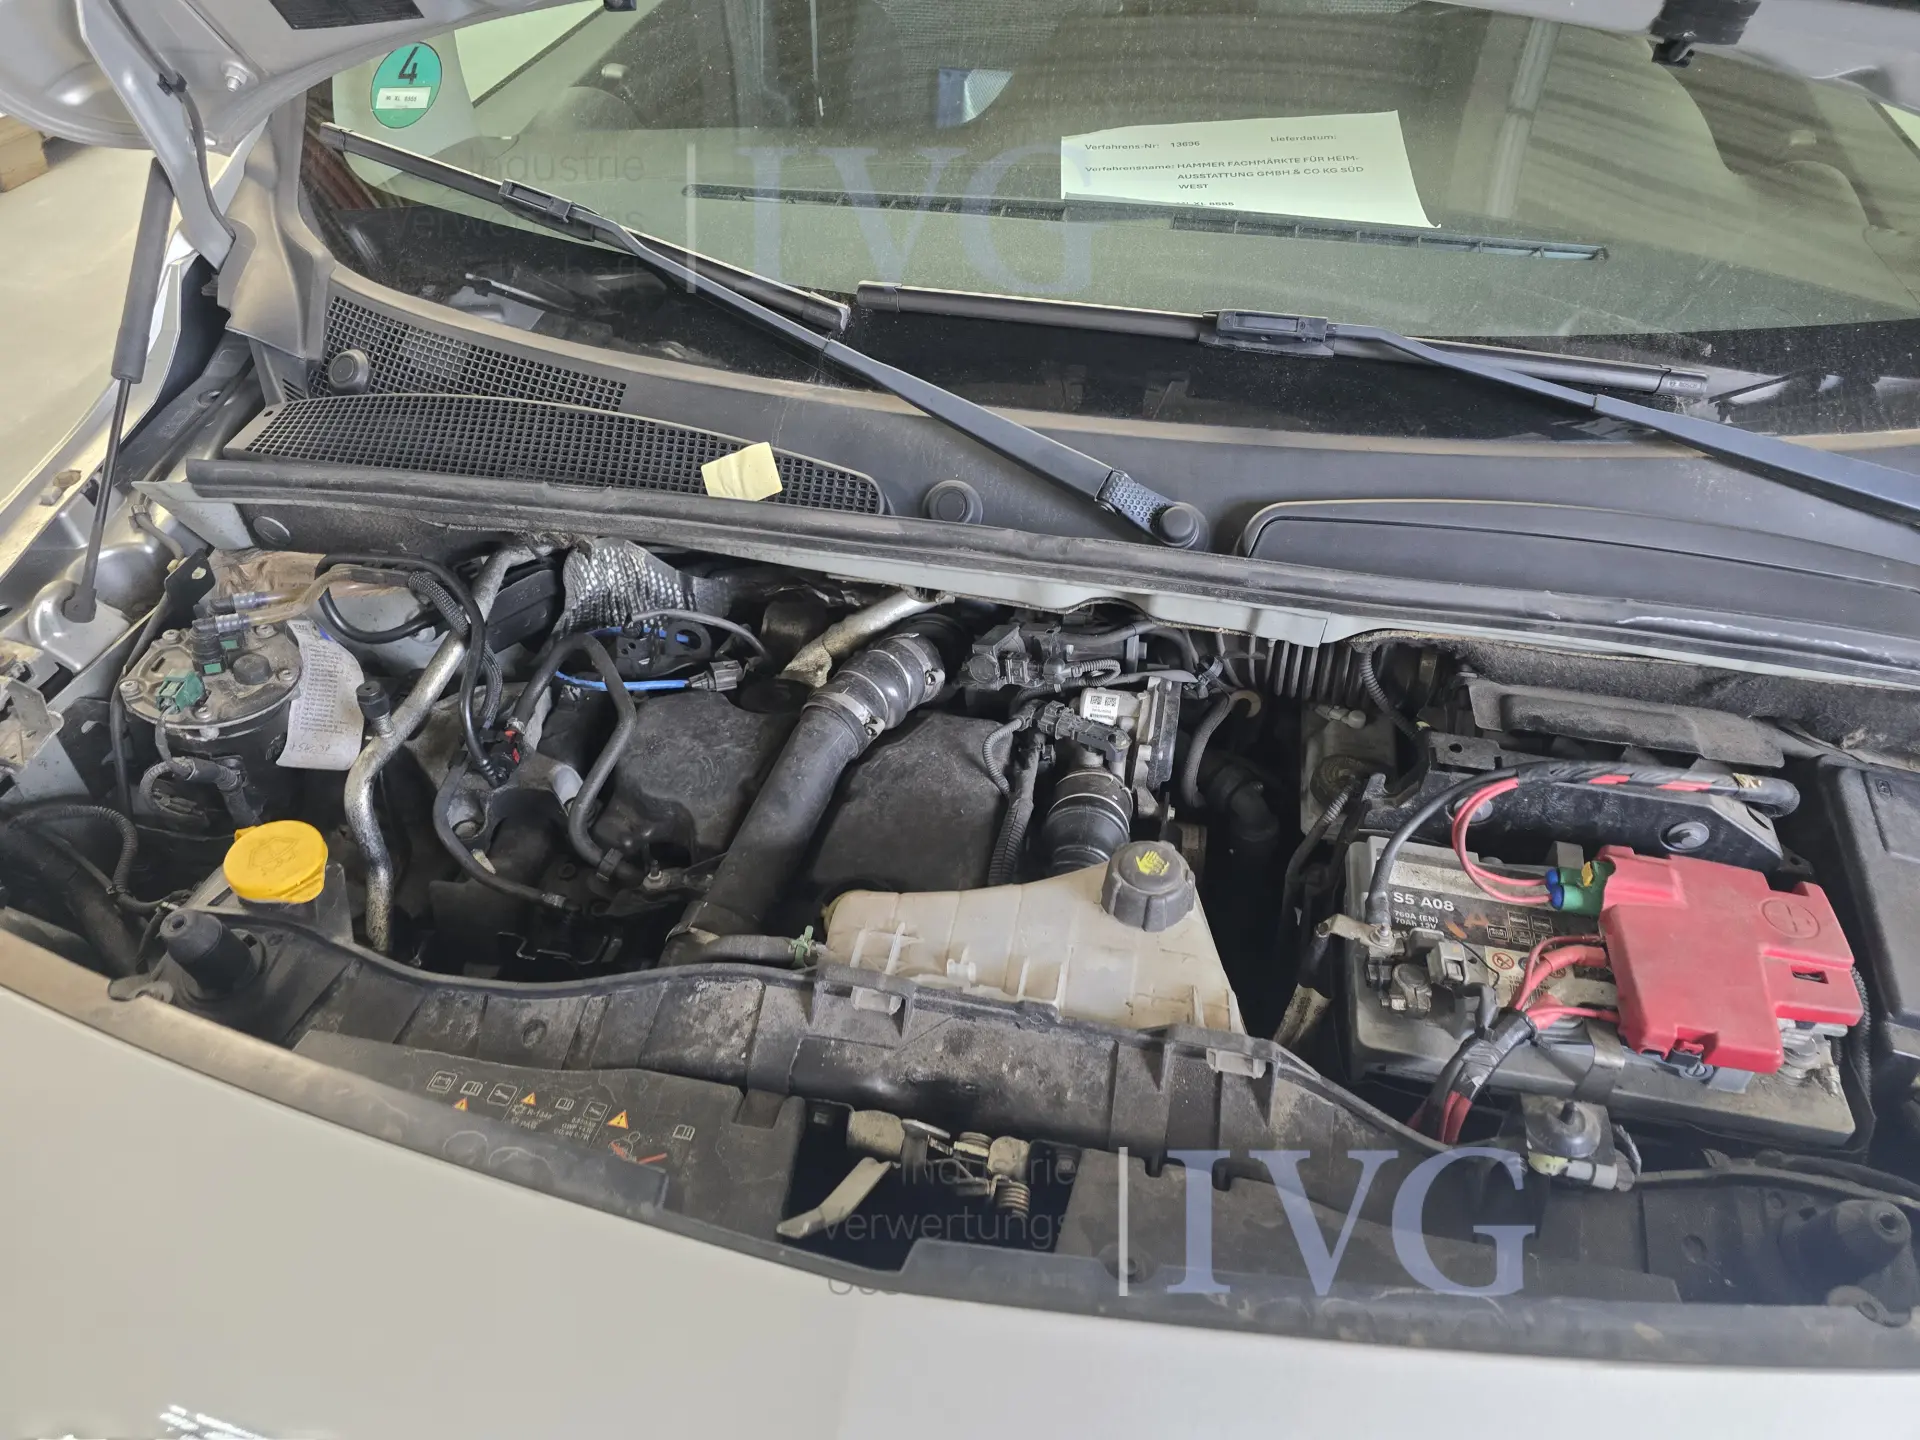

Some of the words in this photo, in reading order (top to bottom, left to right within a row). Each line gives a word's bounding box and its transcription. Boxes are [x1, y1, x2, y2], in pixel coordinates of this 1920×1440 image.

[398, 46, 421, 85] 4
[1270, 134, 1337, 143] Lieferdatum:
[1084, 143, 1160, 151] Verfahrens-Nr:
[1084, 164, 1176, 173] Verfahrensname:
[1177, 161, 1226, 169] HAMMER
[1227, 156, 1301, 168] FACHMÄRKTE
[1303, 154, 1325, 163] FÜR
[1327, 154, 1360, 163] HEIM-
[1177, 171, 1255, 180] AUSSTATTUNG
[1256, 169, 1291, 178] GMBH
[1303, 167, 1320, 176] CO
[1322, 166, 1339, 175] KG
[1340, 165, 1365, 174] SÜD
[1393, 891, 1415, 905] S5
[1420, 896, 1455, 912] A08
[1394, 910, 1417, 920] 760A
[1419, 913, 1439, 924] (EN)
[1395, 917, 1418, 927] 70Ah
